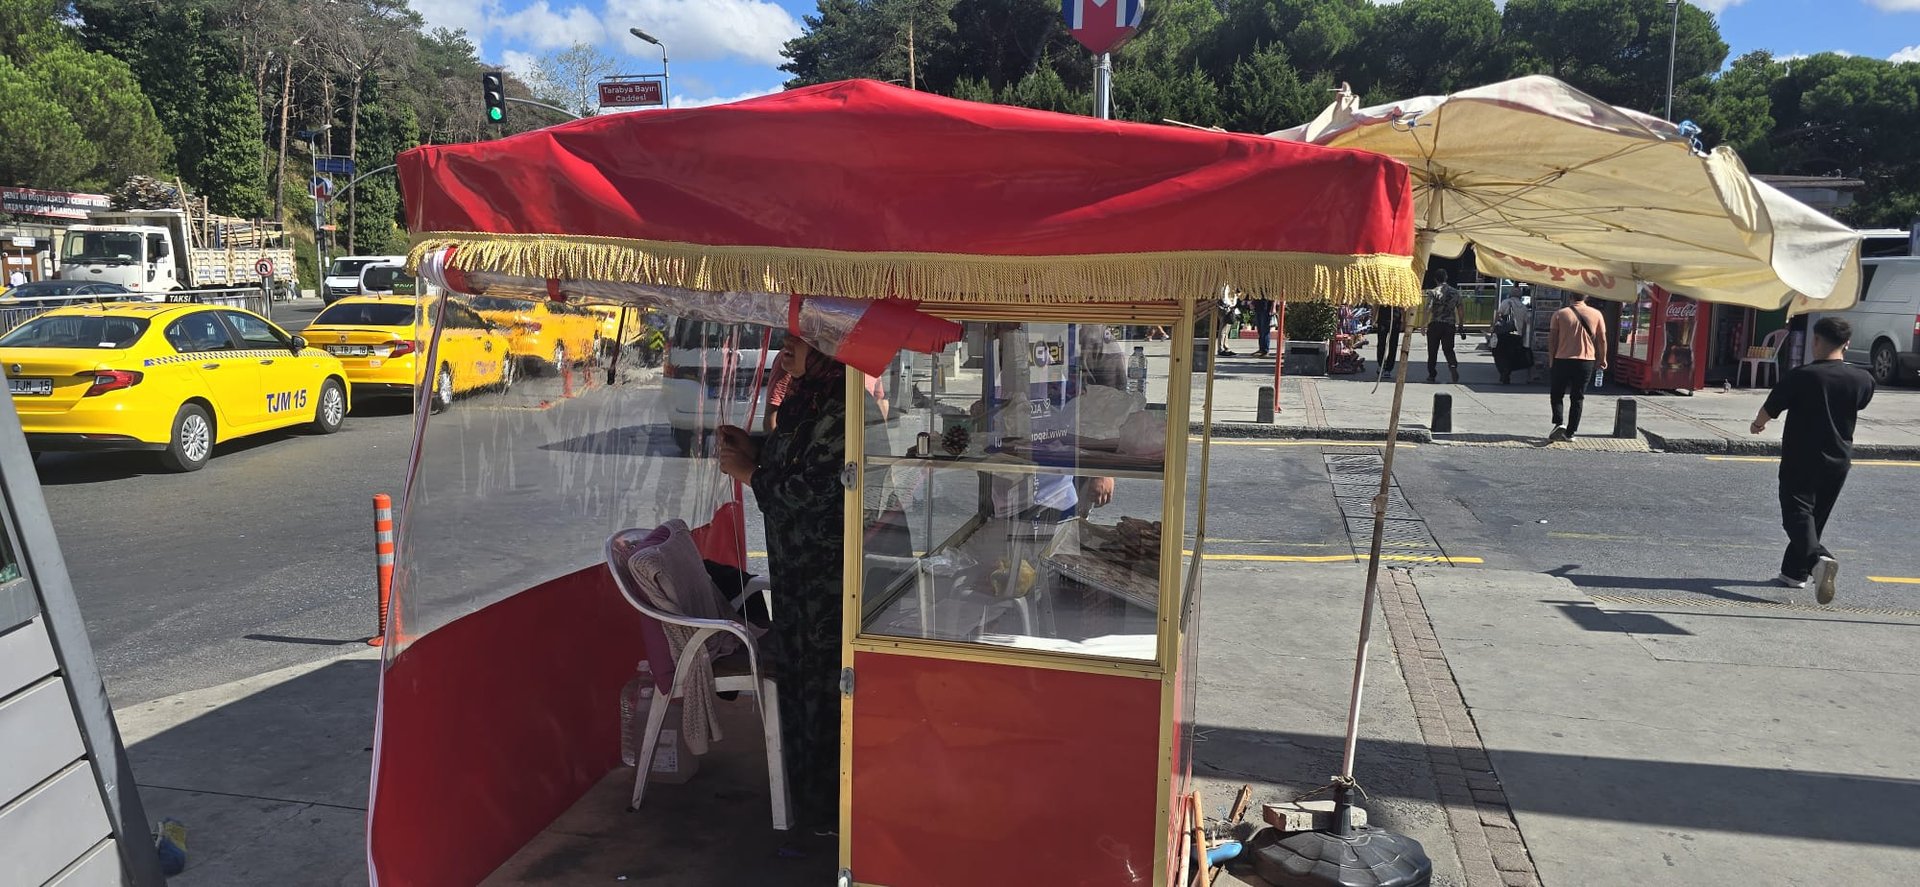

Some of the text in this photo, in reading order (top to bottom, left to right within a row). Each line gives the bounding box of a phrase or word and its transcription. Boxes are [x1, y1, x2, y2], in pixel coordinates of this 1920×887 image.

[604, 86, 633, 94] Tarabya
[615, 93, 647, 102] Caddesi
[15, 380, 50, 392] TJM 15
[266, 389, 307, 413] TJM 15
